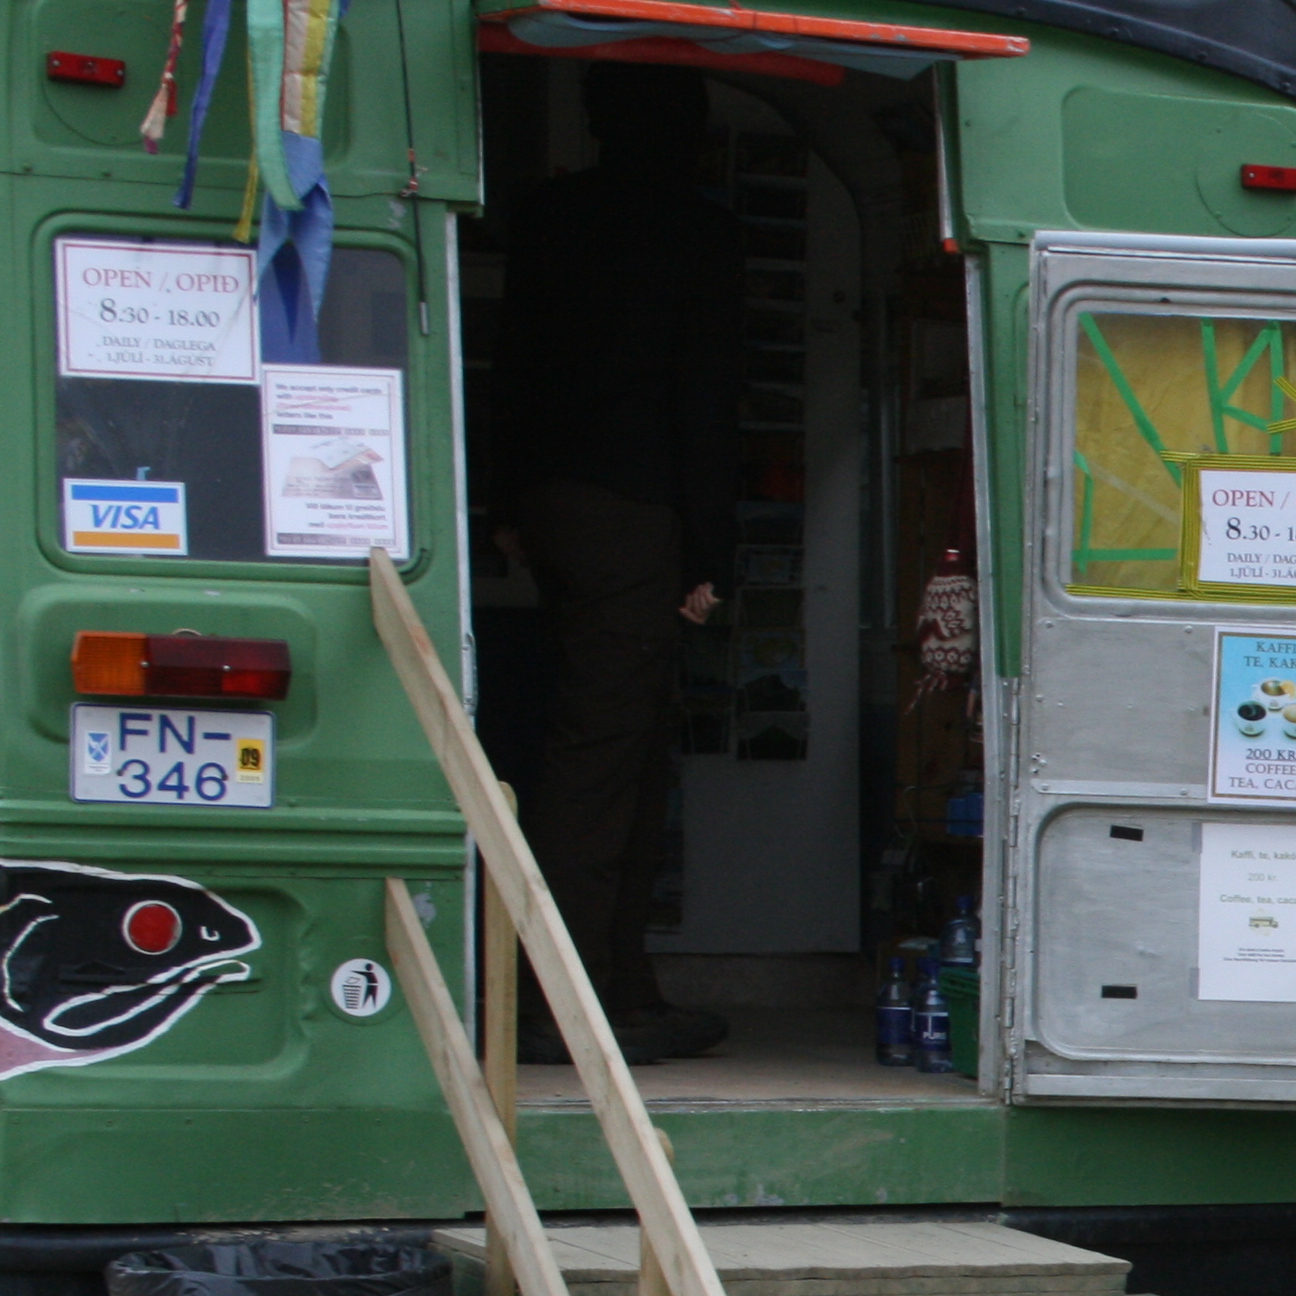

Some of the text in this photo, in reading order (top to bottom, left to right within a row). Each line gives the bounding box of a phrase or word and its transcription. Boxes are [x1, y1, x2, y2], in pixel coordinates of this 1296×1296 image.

[83, 267, 151, 289] OPEN
[176, 273, 239, 293] OPIÐ
[100, 298, 149, 323] 8.30
[168, 309, 220, 327] 18.00
[102, 335, 141, 348] DAILY
[153, 339, 216, 351] DAGLEGA
[1212, 489, 1275, 507] OPEN
[91, 504, 161, 530] VISA
[1226, 517, 1271, 540] 8.30
[1227, 552, 1262, 564] DAILY
[119, 712, 231, 755] FN-
[1246, 748, 1272, 760] 200
[119, 759, 226, 801] 346
[1248, 873, 1265, 881] 200
